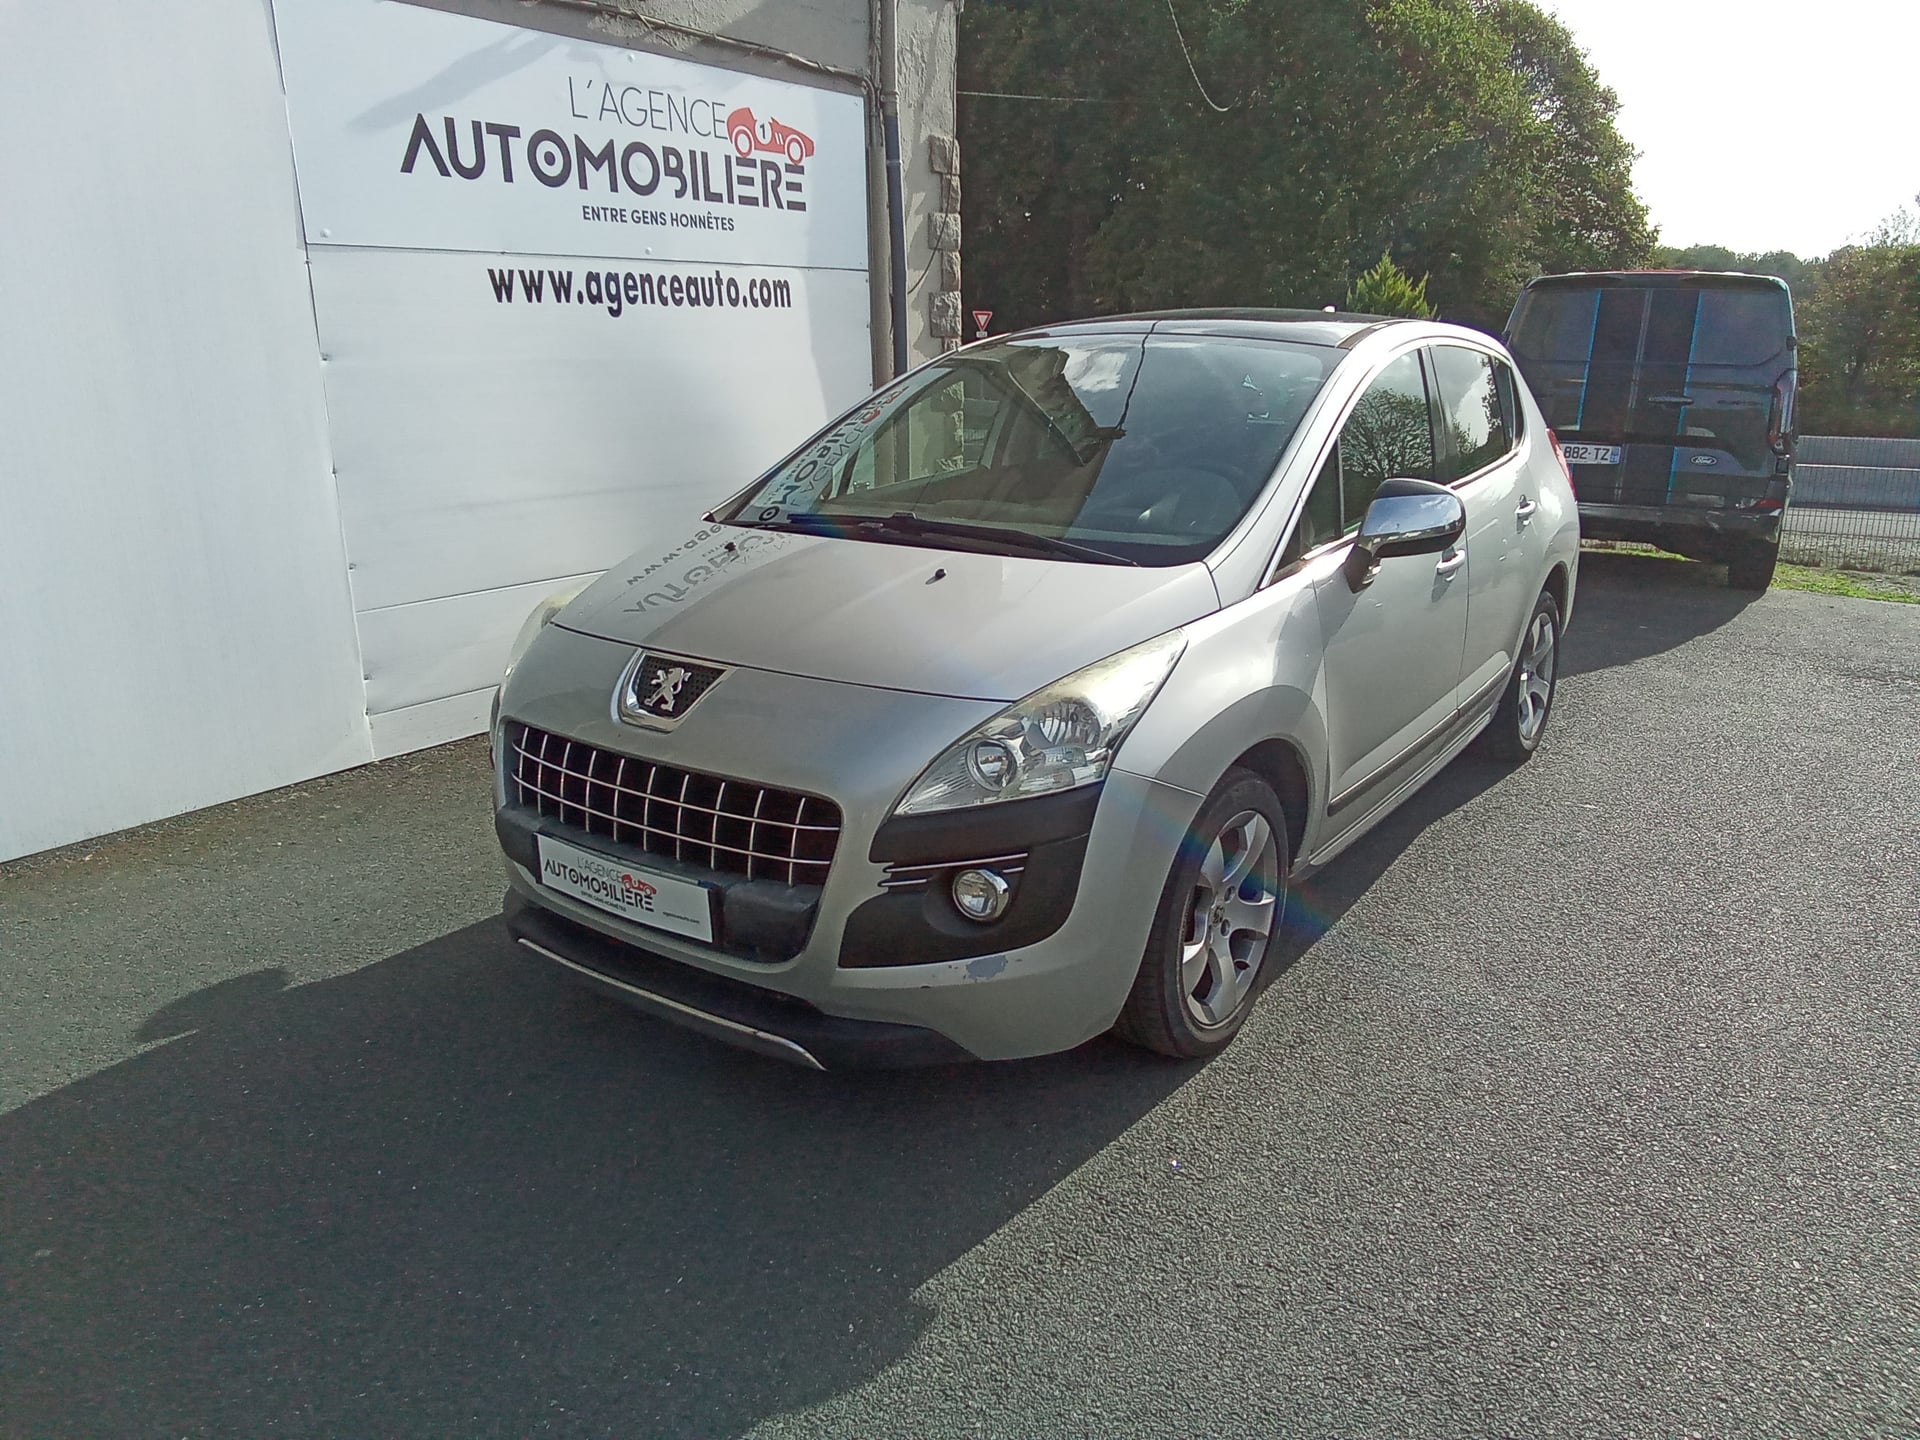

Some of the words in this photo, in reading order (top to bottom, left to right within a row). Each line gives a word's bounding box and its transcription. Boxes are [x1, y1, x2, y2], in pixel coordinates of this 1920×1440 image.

[568, 76, 728, 140] L'AGENCE
[400, 113, 807, 212] AUTOMOBILIERE
[582, 205, 628, 224] ENTRE
[631, 209, 667, 226] GENS
[670, 211, 735, 231] HONNÊTES
[487, 267, 792, 318] www.agenceauto.com
[544, 859, 655, 912] AUTOMOBILIERE
